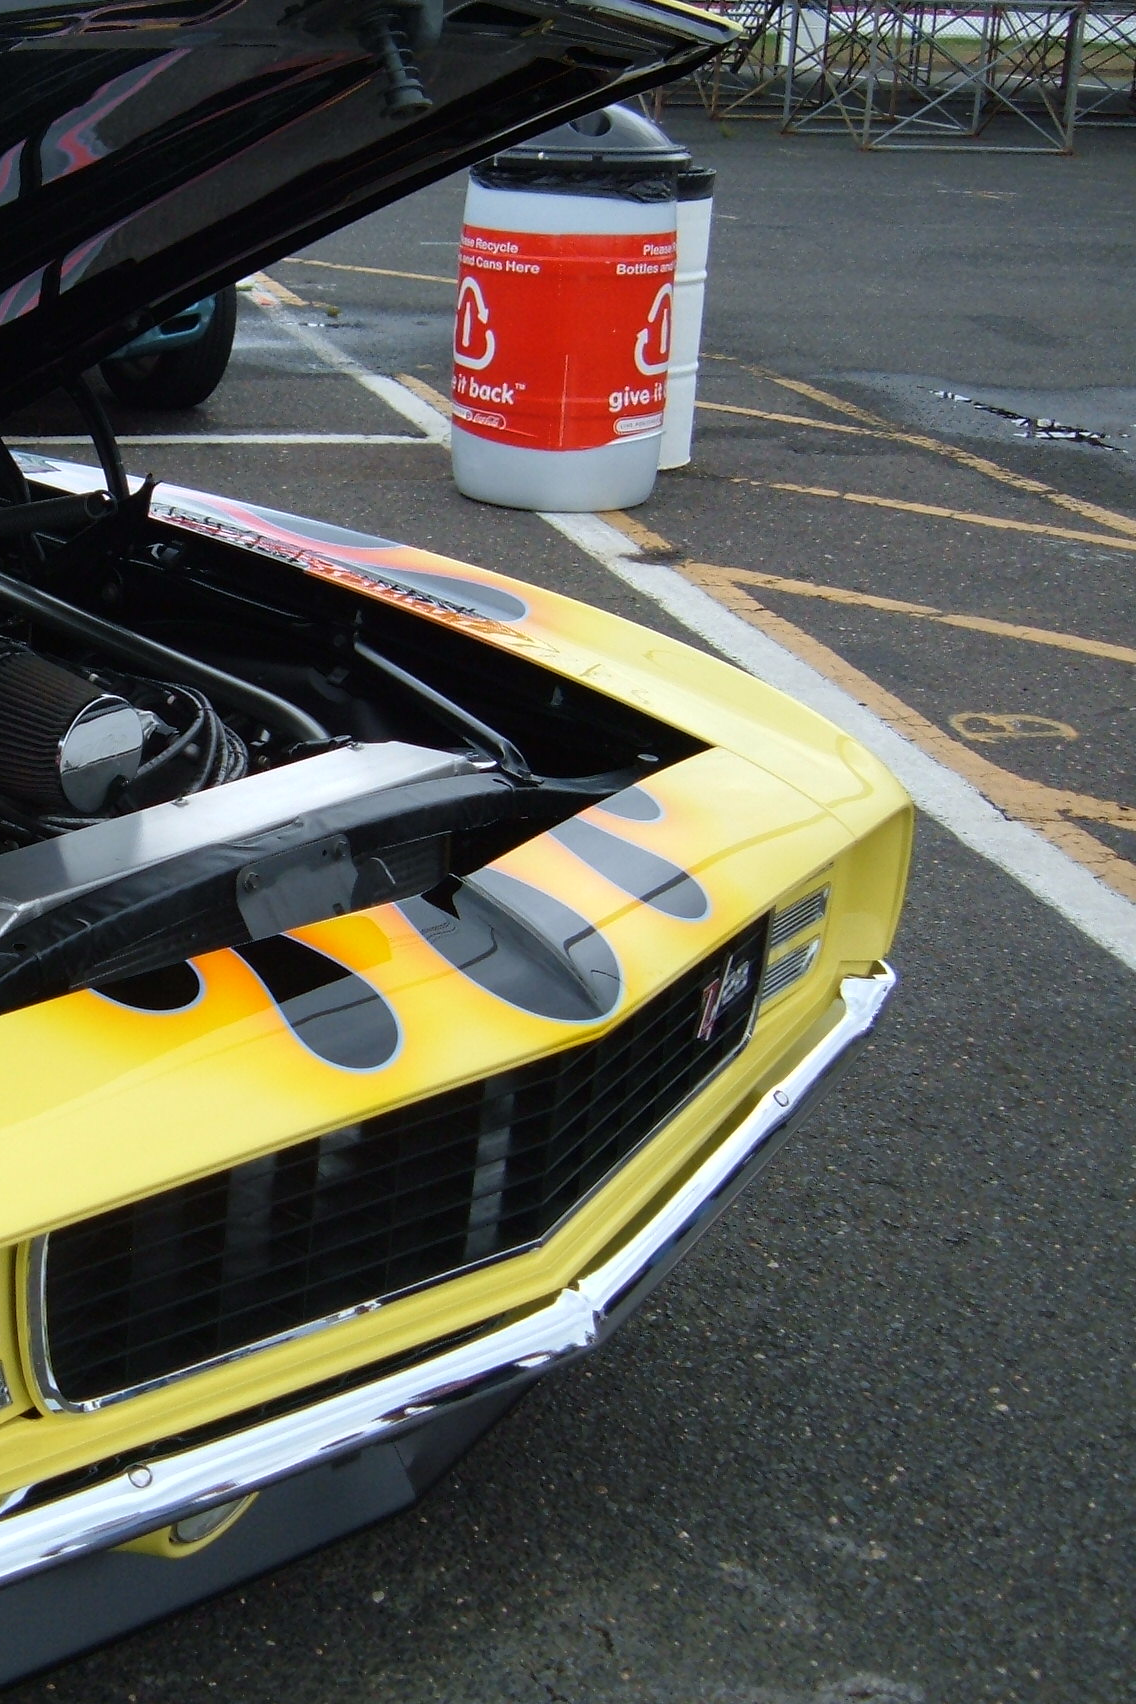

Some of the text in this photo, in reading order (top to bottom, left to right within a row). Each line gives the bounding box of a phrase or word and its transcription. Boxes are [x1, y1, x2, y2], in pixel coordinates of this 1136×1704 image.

[475, 238, 519, 254] Recycle
[476, 256, 503, 271] Cans
[505, 260, 540, 275] Here
[616, 263, 659, 275] Bottles
[457, 373, 467, 394] it
[469, 376, 514, 405] back
[608, 382, 662, 413] give it
